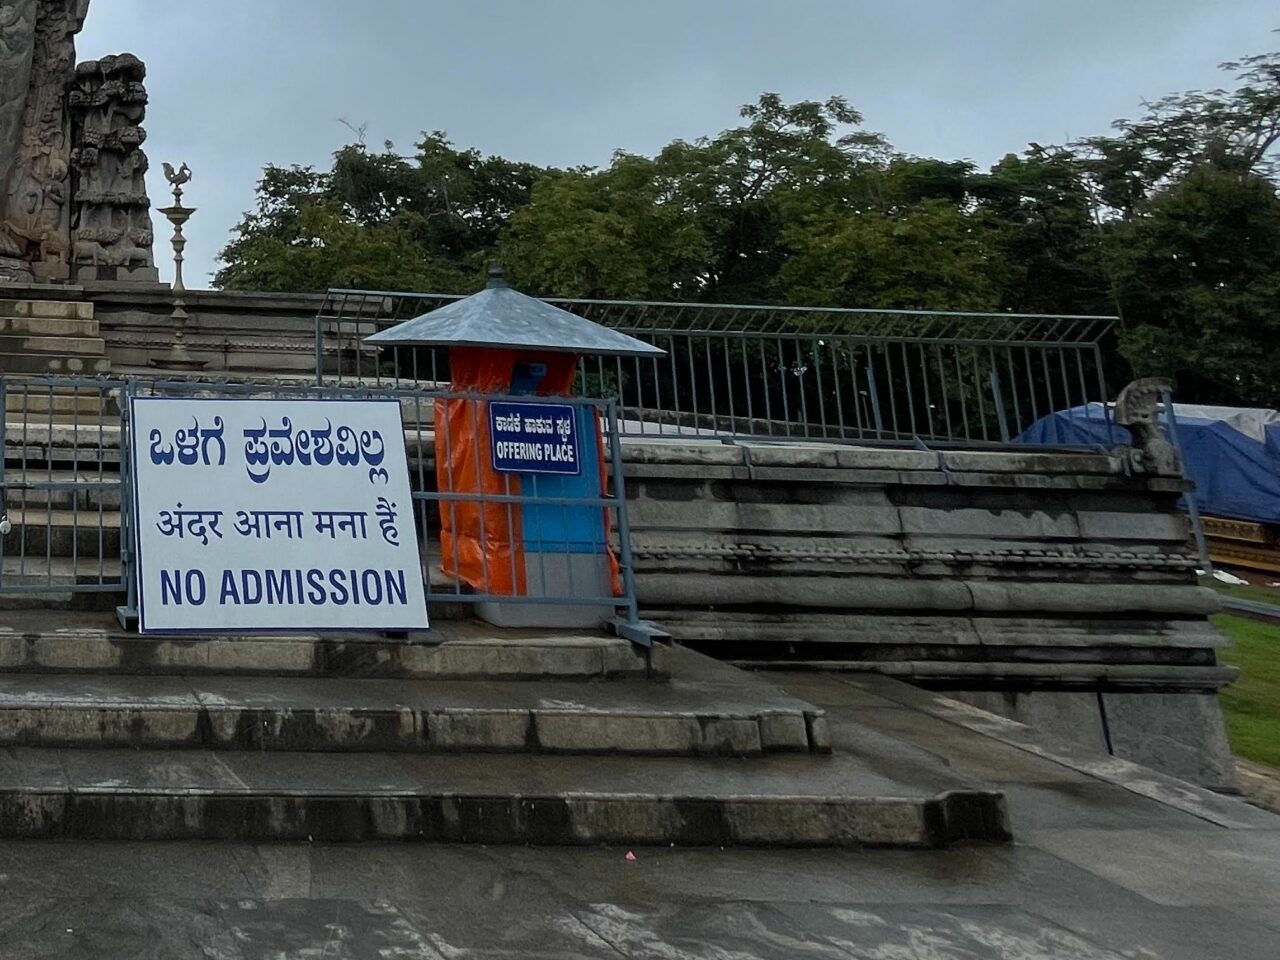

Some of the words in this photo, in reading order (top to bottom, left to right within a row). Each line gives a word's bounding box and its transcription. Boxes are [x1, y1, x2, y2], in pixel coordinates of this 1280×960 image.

[149, 415, 227, 466] ಒಳಗೆ
[243, 415, 389, 485] ಪ್ರವೇಶವಿಲ್ಲ
[496, 441, 543, 461] OFFERING
[544, 443, 574, 462] PLACE
[156, 502, 223, 546] अंदर
[233, 510, 304, 539] आना
[312, 510, 368, 539] मना
[375, 496, 400, 547] हैं
[160, 568, 206, 606] NO
[219, 568, 408, 606] ADMISSION
